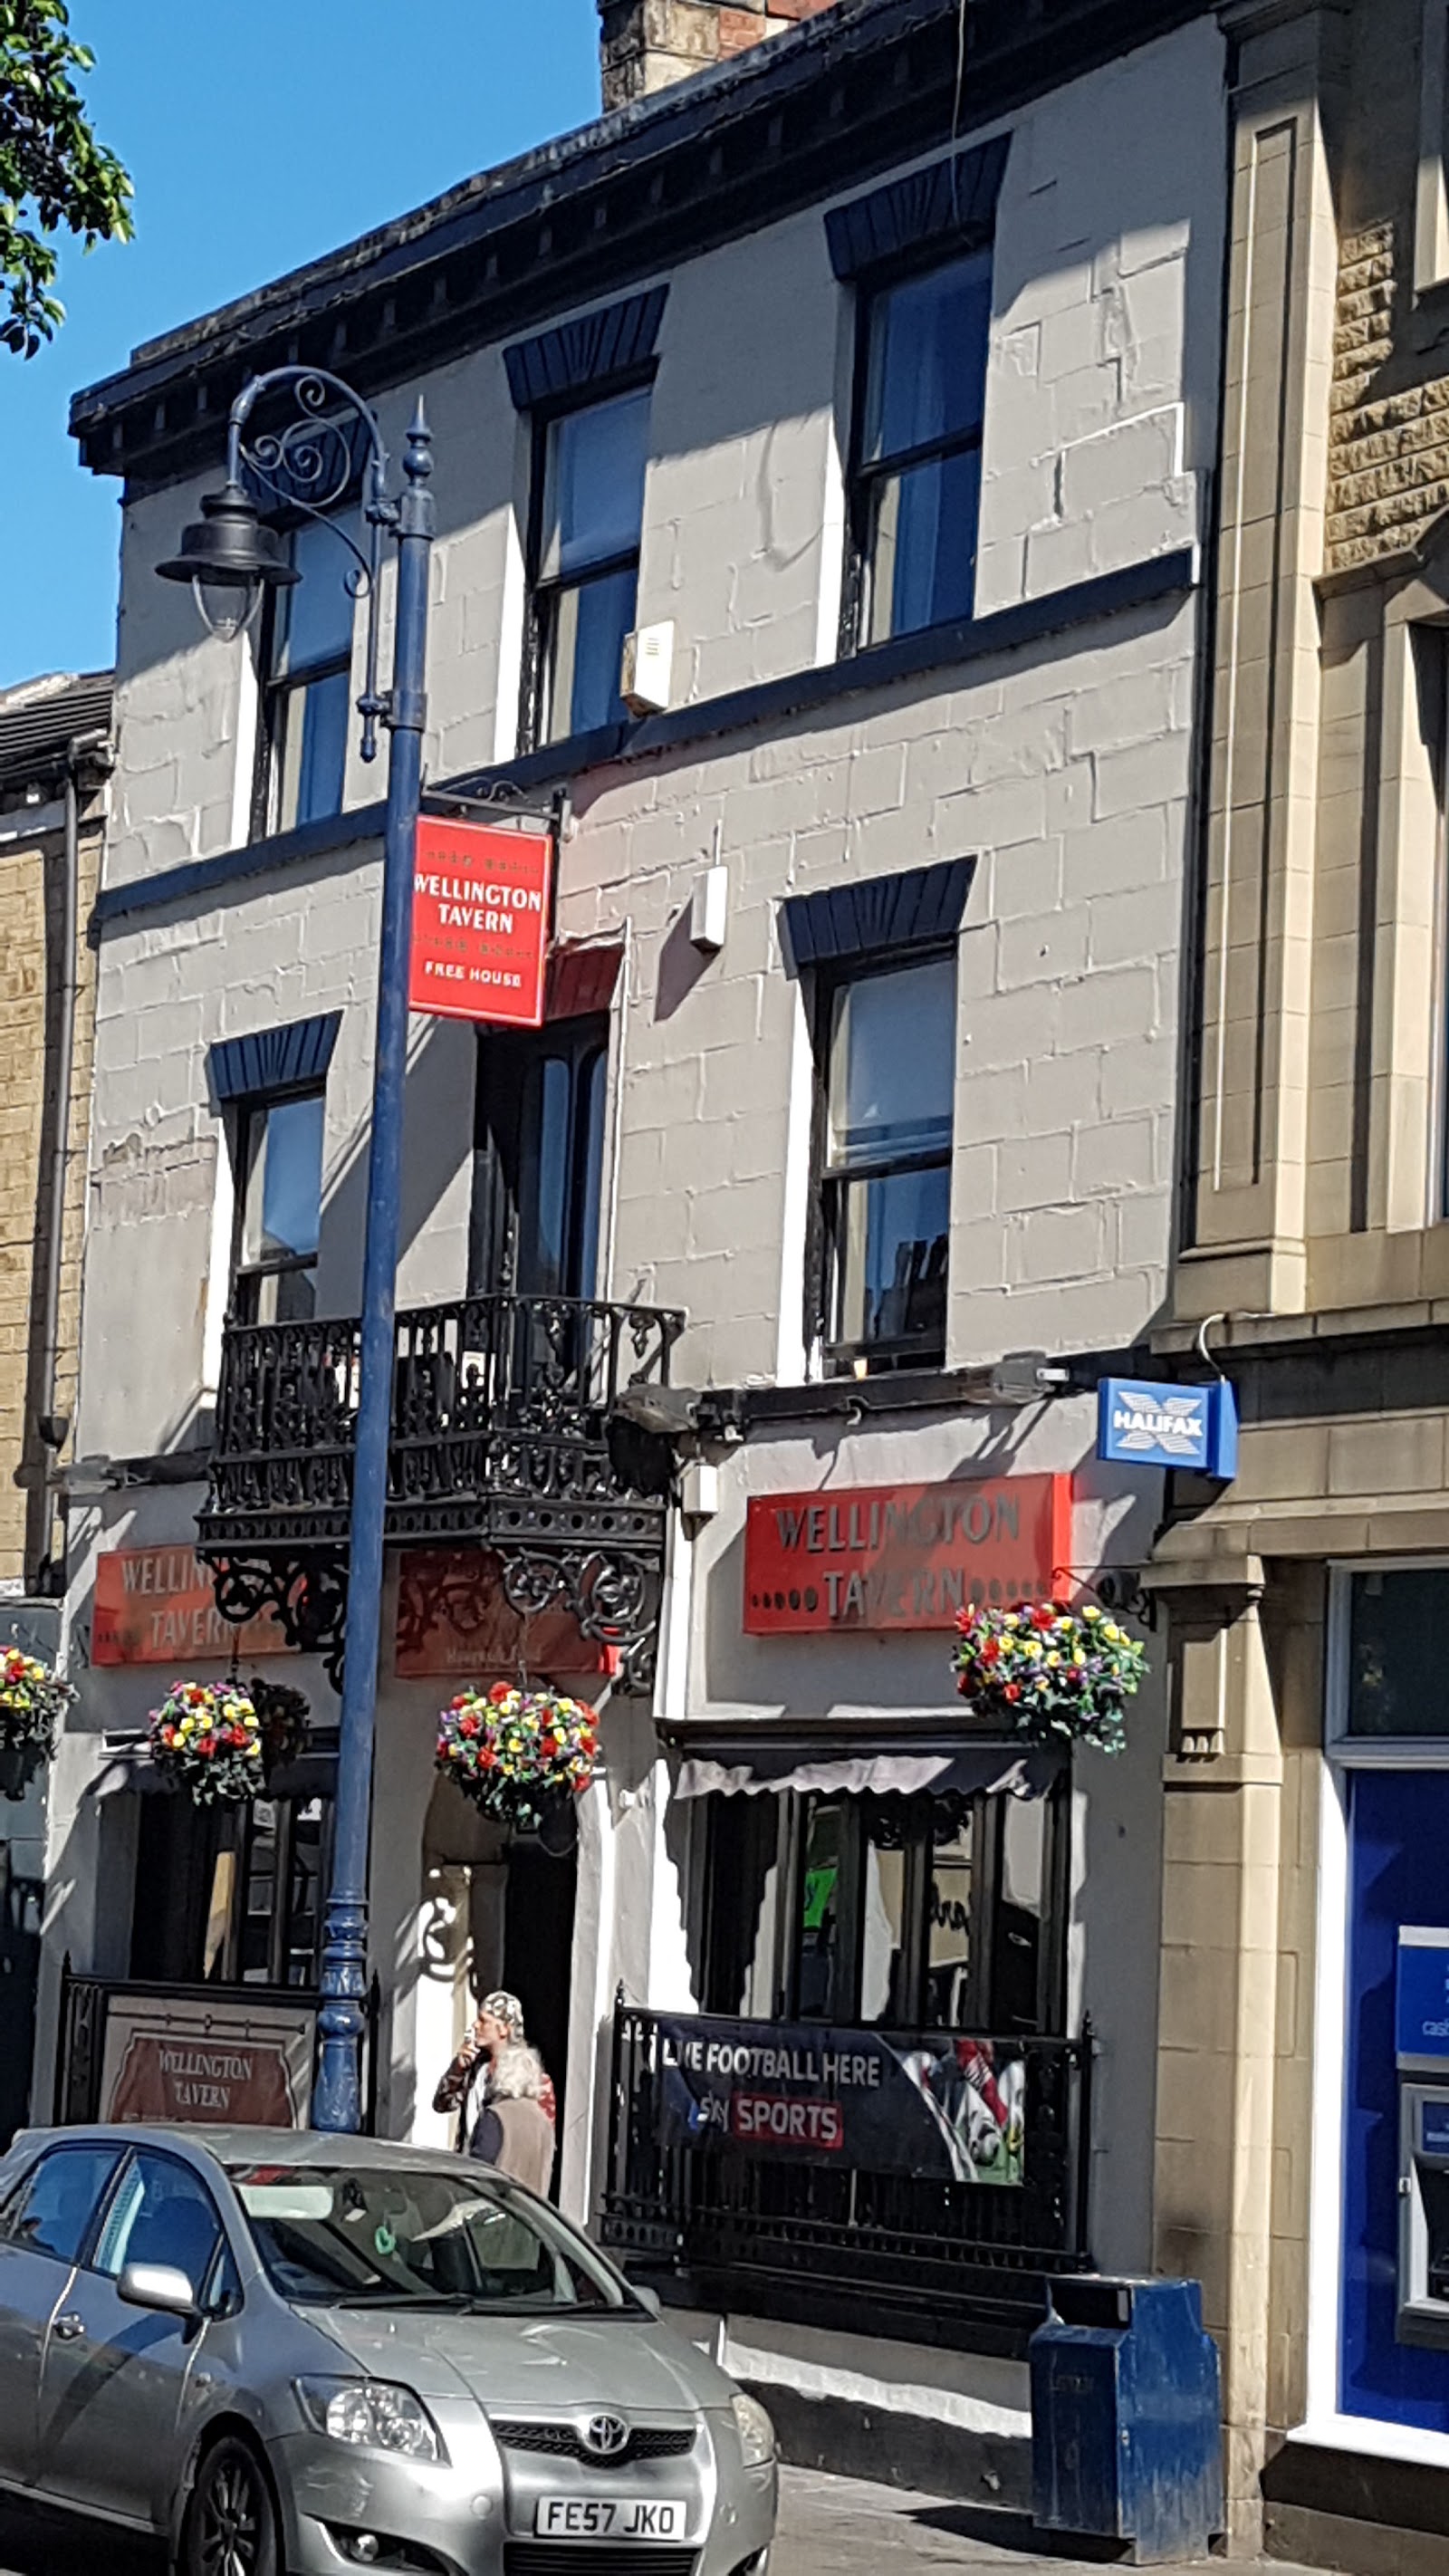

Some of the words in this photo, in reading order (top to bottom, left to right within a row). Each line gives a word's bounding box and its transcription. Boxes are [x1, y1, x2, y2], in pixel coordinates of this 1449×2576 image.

[414, 873, 542, 912] WELLINGTON
[438, 903, 513, 934] TAVERN
[425, 960, 465, 980] FREE
[469, 967, 522, 988] HOUSE
[1113, 1409, 1203, 1437] HALIFAX
[776, 1495, 1020, 1553] WELLINGTON
[121, 1553, 217, 1595] WELLIN
[822, 1567, 965, 1621] TAVERN
[158, 2049, 253, 2081] WELLINGTON
[706, 2043, 820, 2082] FOOTBALL
[822, 2052, 880, 2088] HERE
[173, 2080, 231, 2110] TAVERN
[736, 2098, 838, 2140] SPORTS
[547, 2501, 617, 2533] FE57
[623, 2504, 675, 2534] JKO
